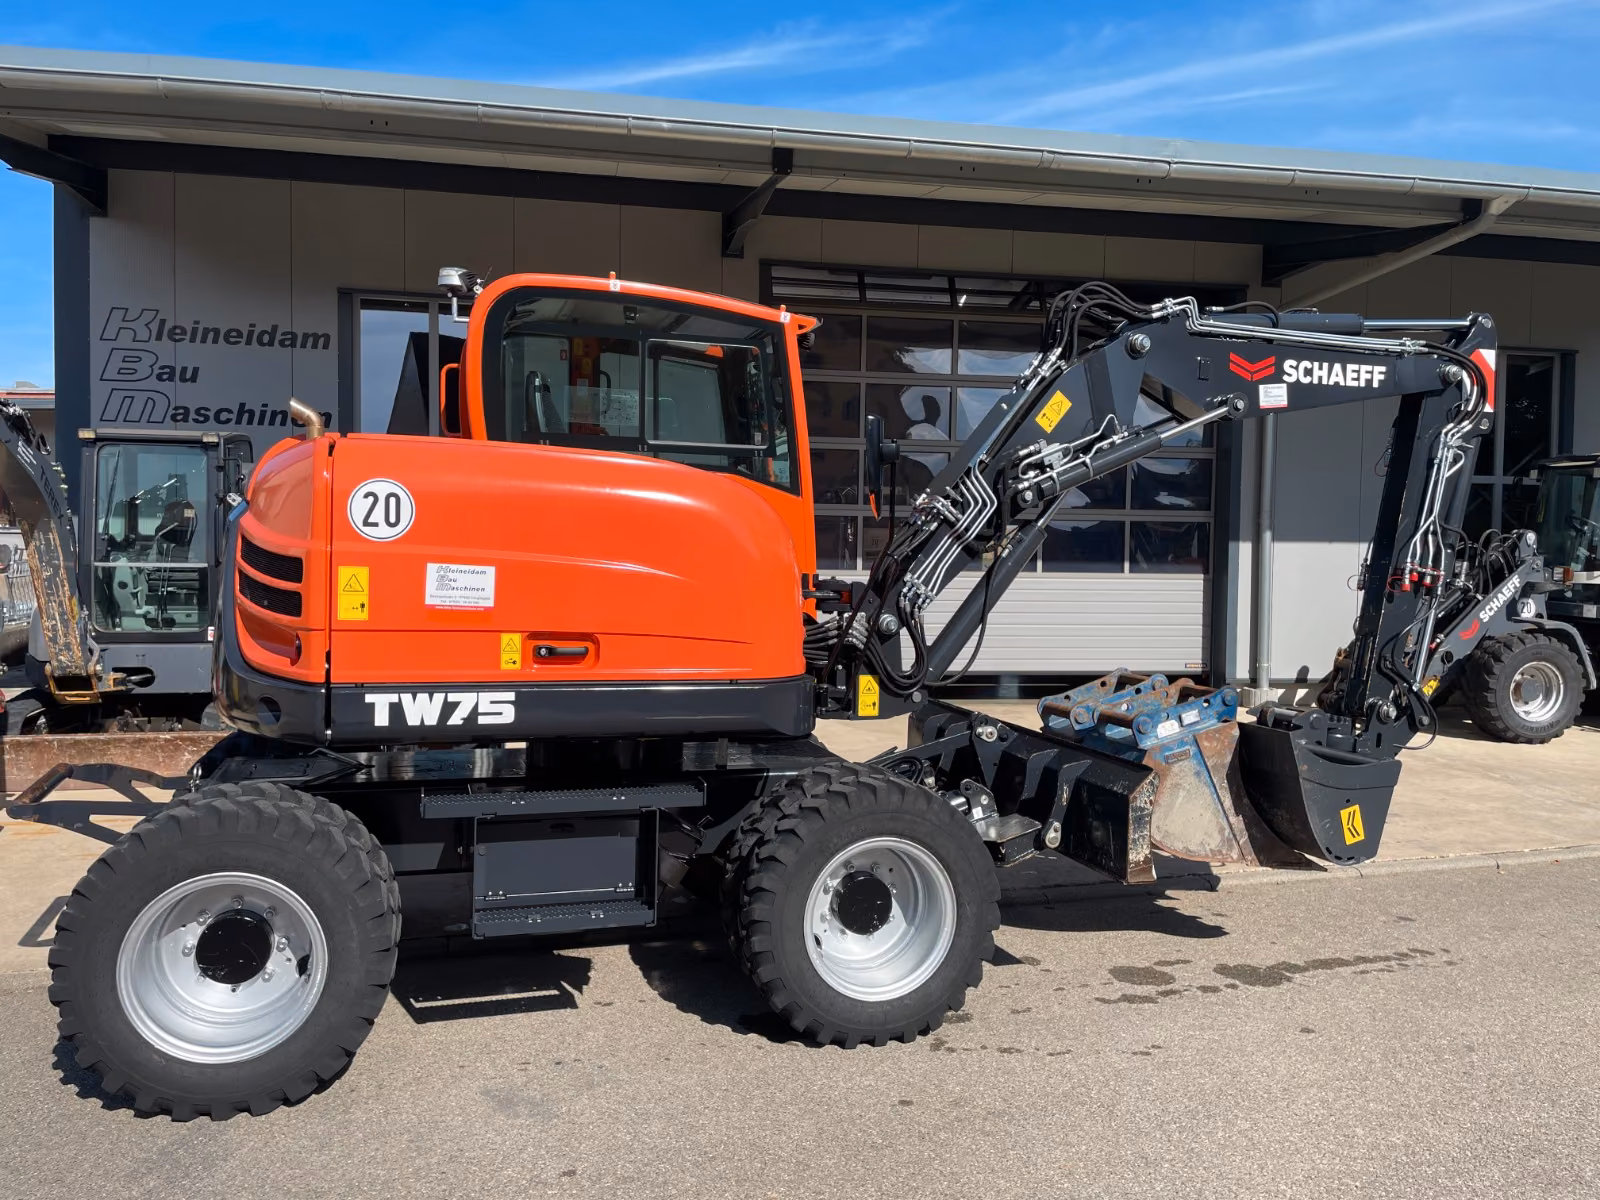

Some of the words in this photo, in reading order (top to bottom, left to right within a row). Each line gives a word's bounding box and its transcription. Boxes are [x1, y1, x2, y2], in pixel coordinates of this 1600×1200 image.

[100, 306, 331, 350] Kleineidam
[100, 347, 200, 383] Bau
[1283, 359, 1387, 388] SCHAEFF
[362, 490, 401, 528] 20
[436, 565, 487, 575] Kleineidam
[436, 574, 458, 583] Bau
[435, 583, 486, 592] Maschinen
[1479, 574, 1522, 623] SCHAEFF
[1520, 601, 1532, 614] 20
[364, 691, 516, 727] TW75
